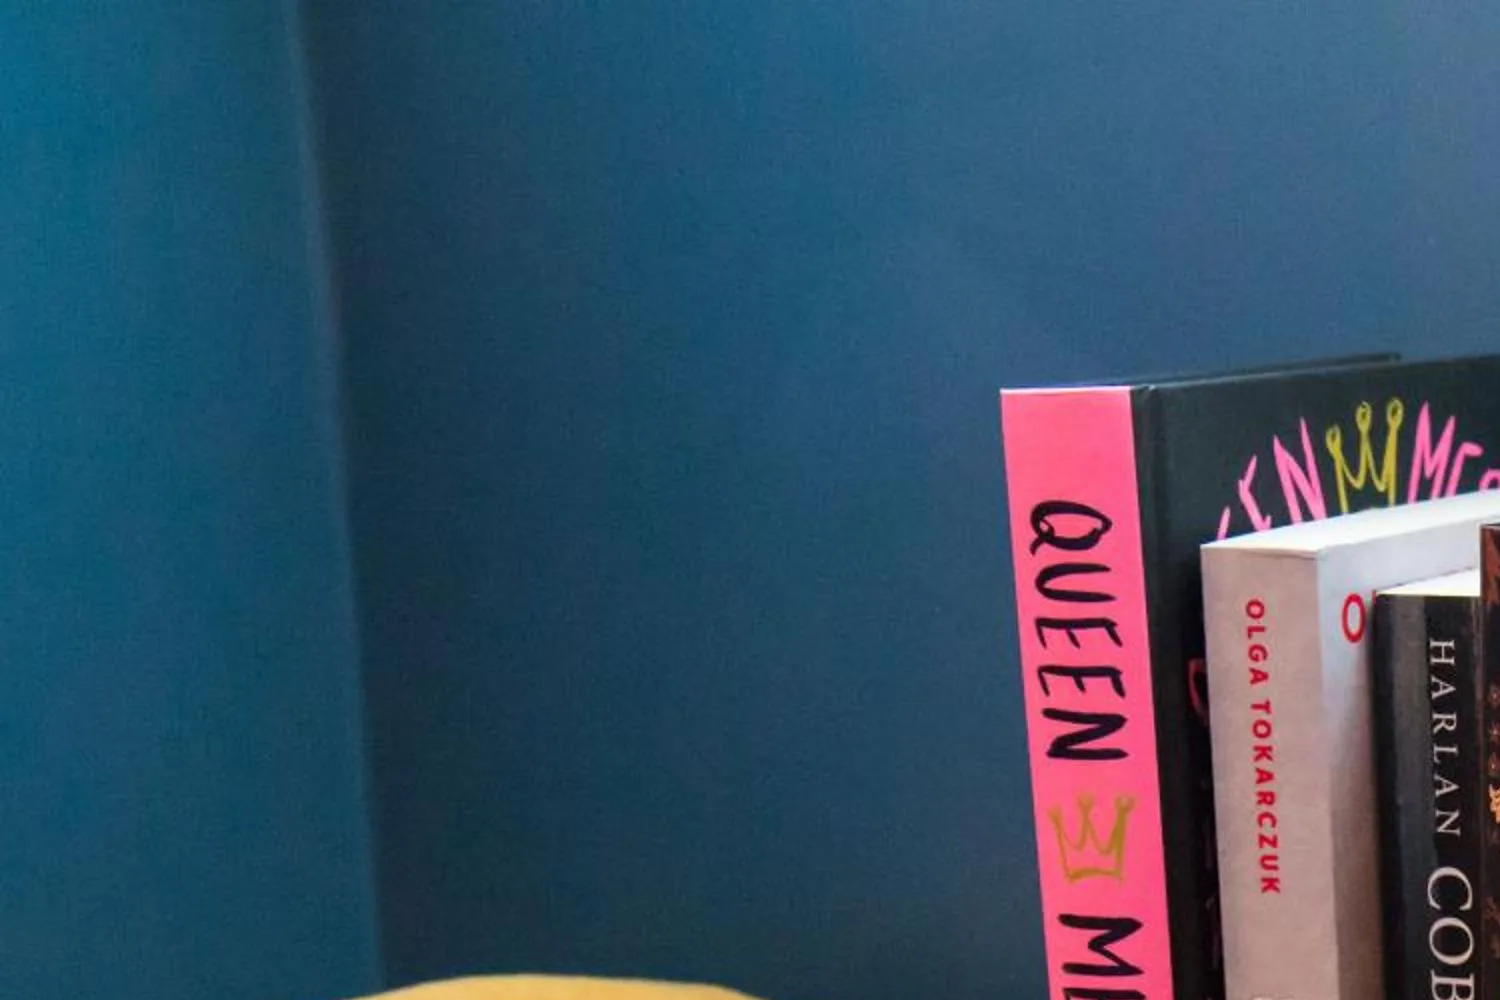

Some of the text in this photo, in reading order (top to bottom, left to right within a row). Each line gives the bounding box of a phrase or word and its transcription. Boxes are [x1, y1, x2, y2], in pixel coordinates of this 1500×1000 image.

[1030, 500, 1128, 761] QUEEN
[1245, 599, 1281, 893] OLGA TOKARCZUK
[1428, 639, 1464, 837] HARLAN
